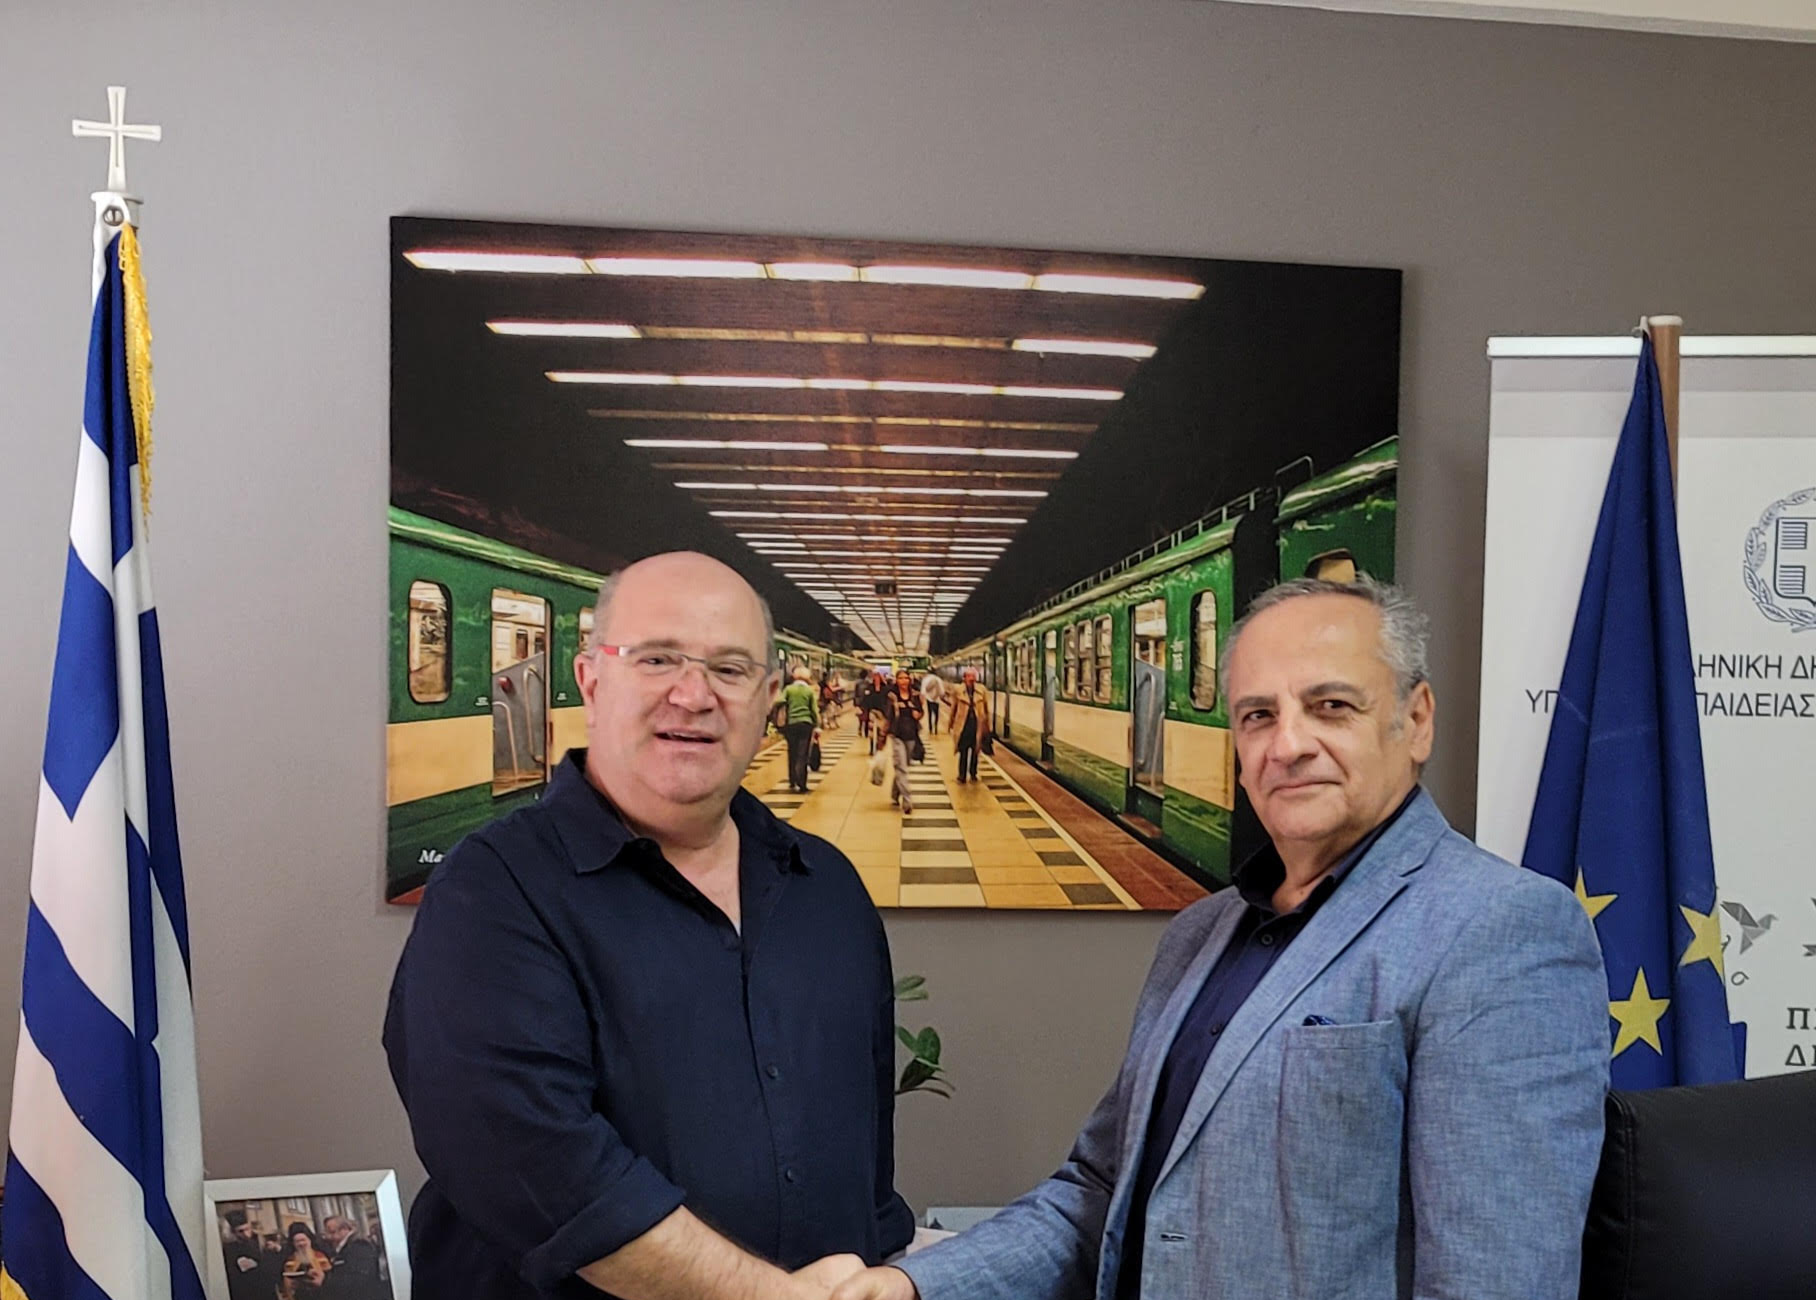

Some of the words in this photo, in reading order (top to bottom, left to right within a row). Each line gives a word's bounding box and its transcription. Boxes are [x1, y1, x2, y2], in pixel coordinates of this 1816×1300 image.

[1694, 654, 1783, 679] ΗΝΙΚΗ
[1525, 688, 1560, 714] ΥΠ
[418, 849, 446, 864] Ma
